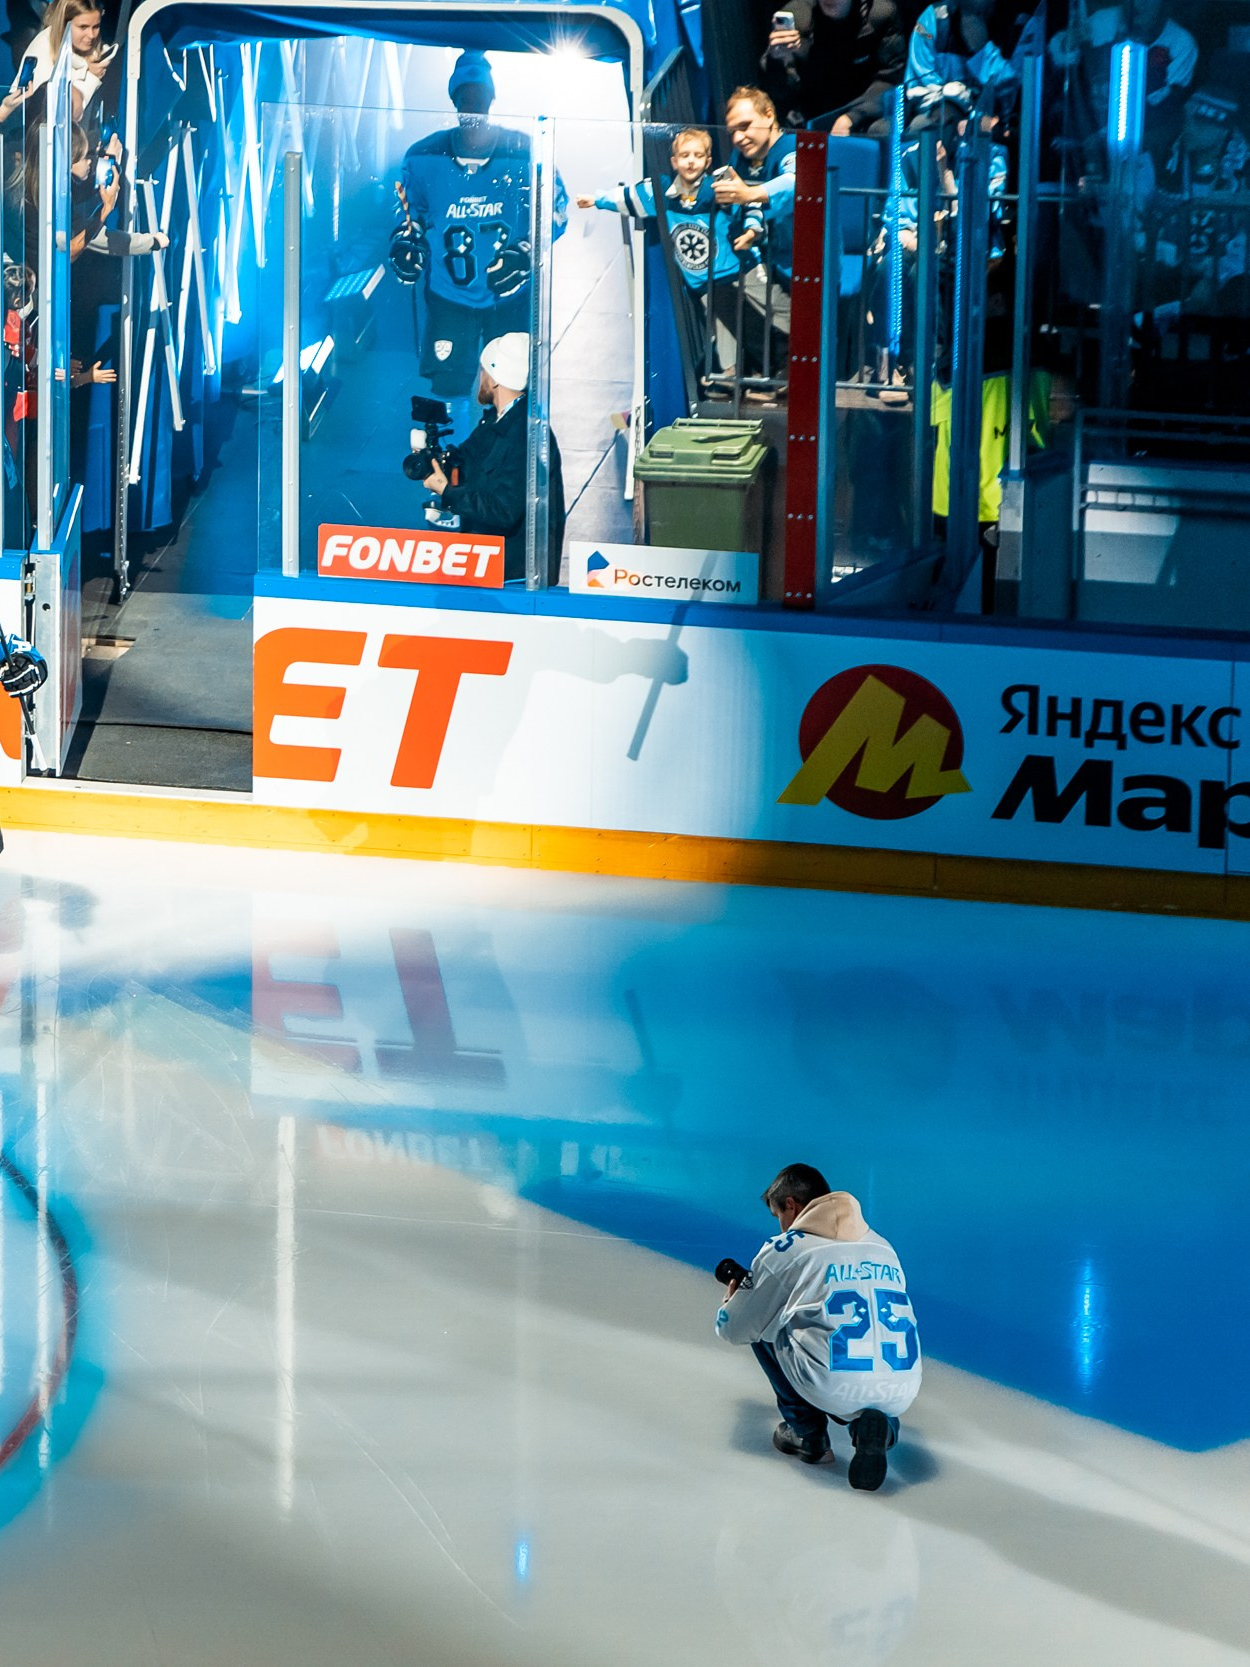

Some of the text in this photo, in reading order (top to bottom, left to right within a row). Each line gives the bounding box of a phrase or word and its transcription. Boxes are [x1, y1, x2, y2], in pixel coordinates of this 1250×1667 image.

[443, 220, 512, 286] 87
[321, 535, 501, 578] FONBET
[614, 569, 741, 593] Ростелеком
[999, 684, 1241, 750] Яндекс
[824, 1287, 919, 1373] 25
